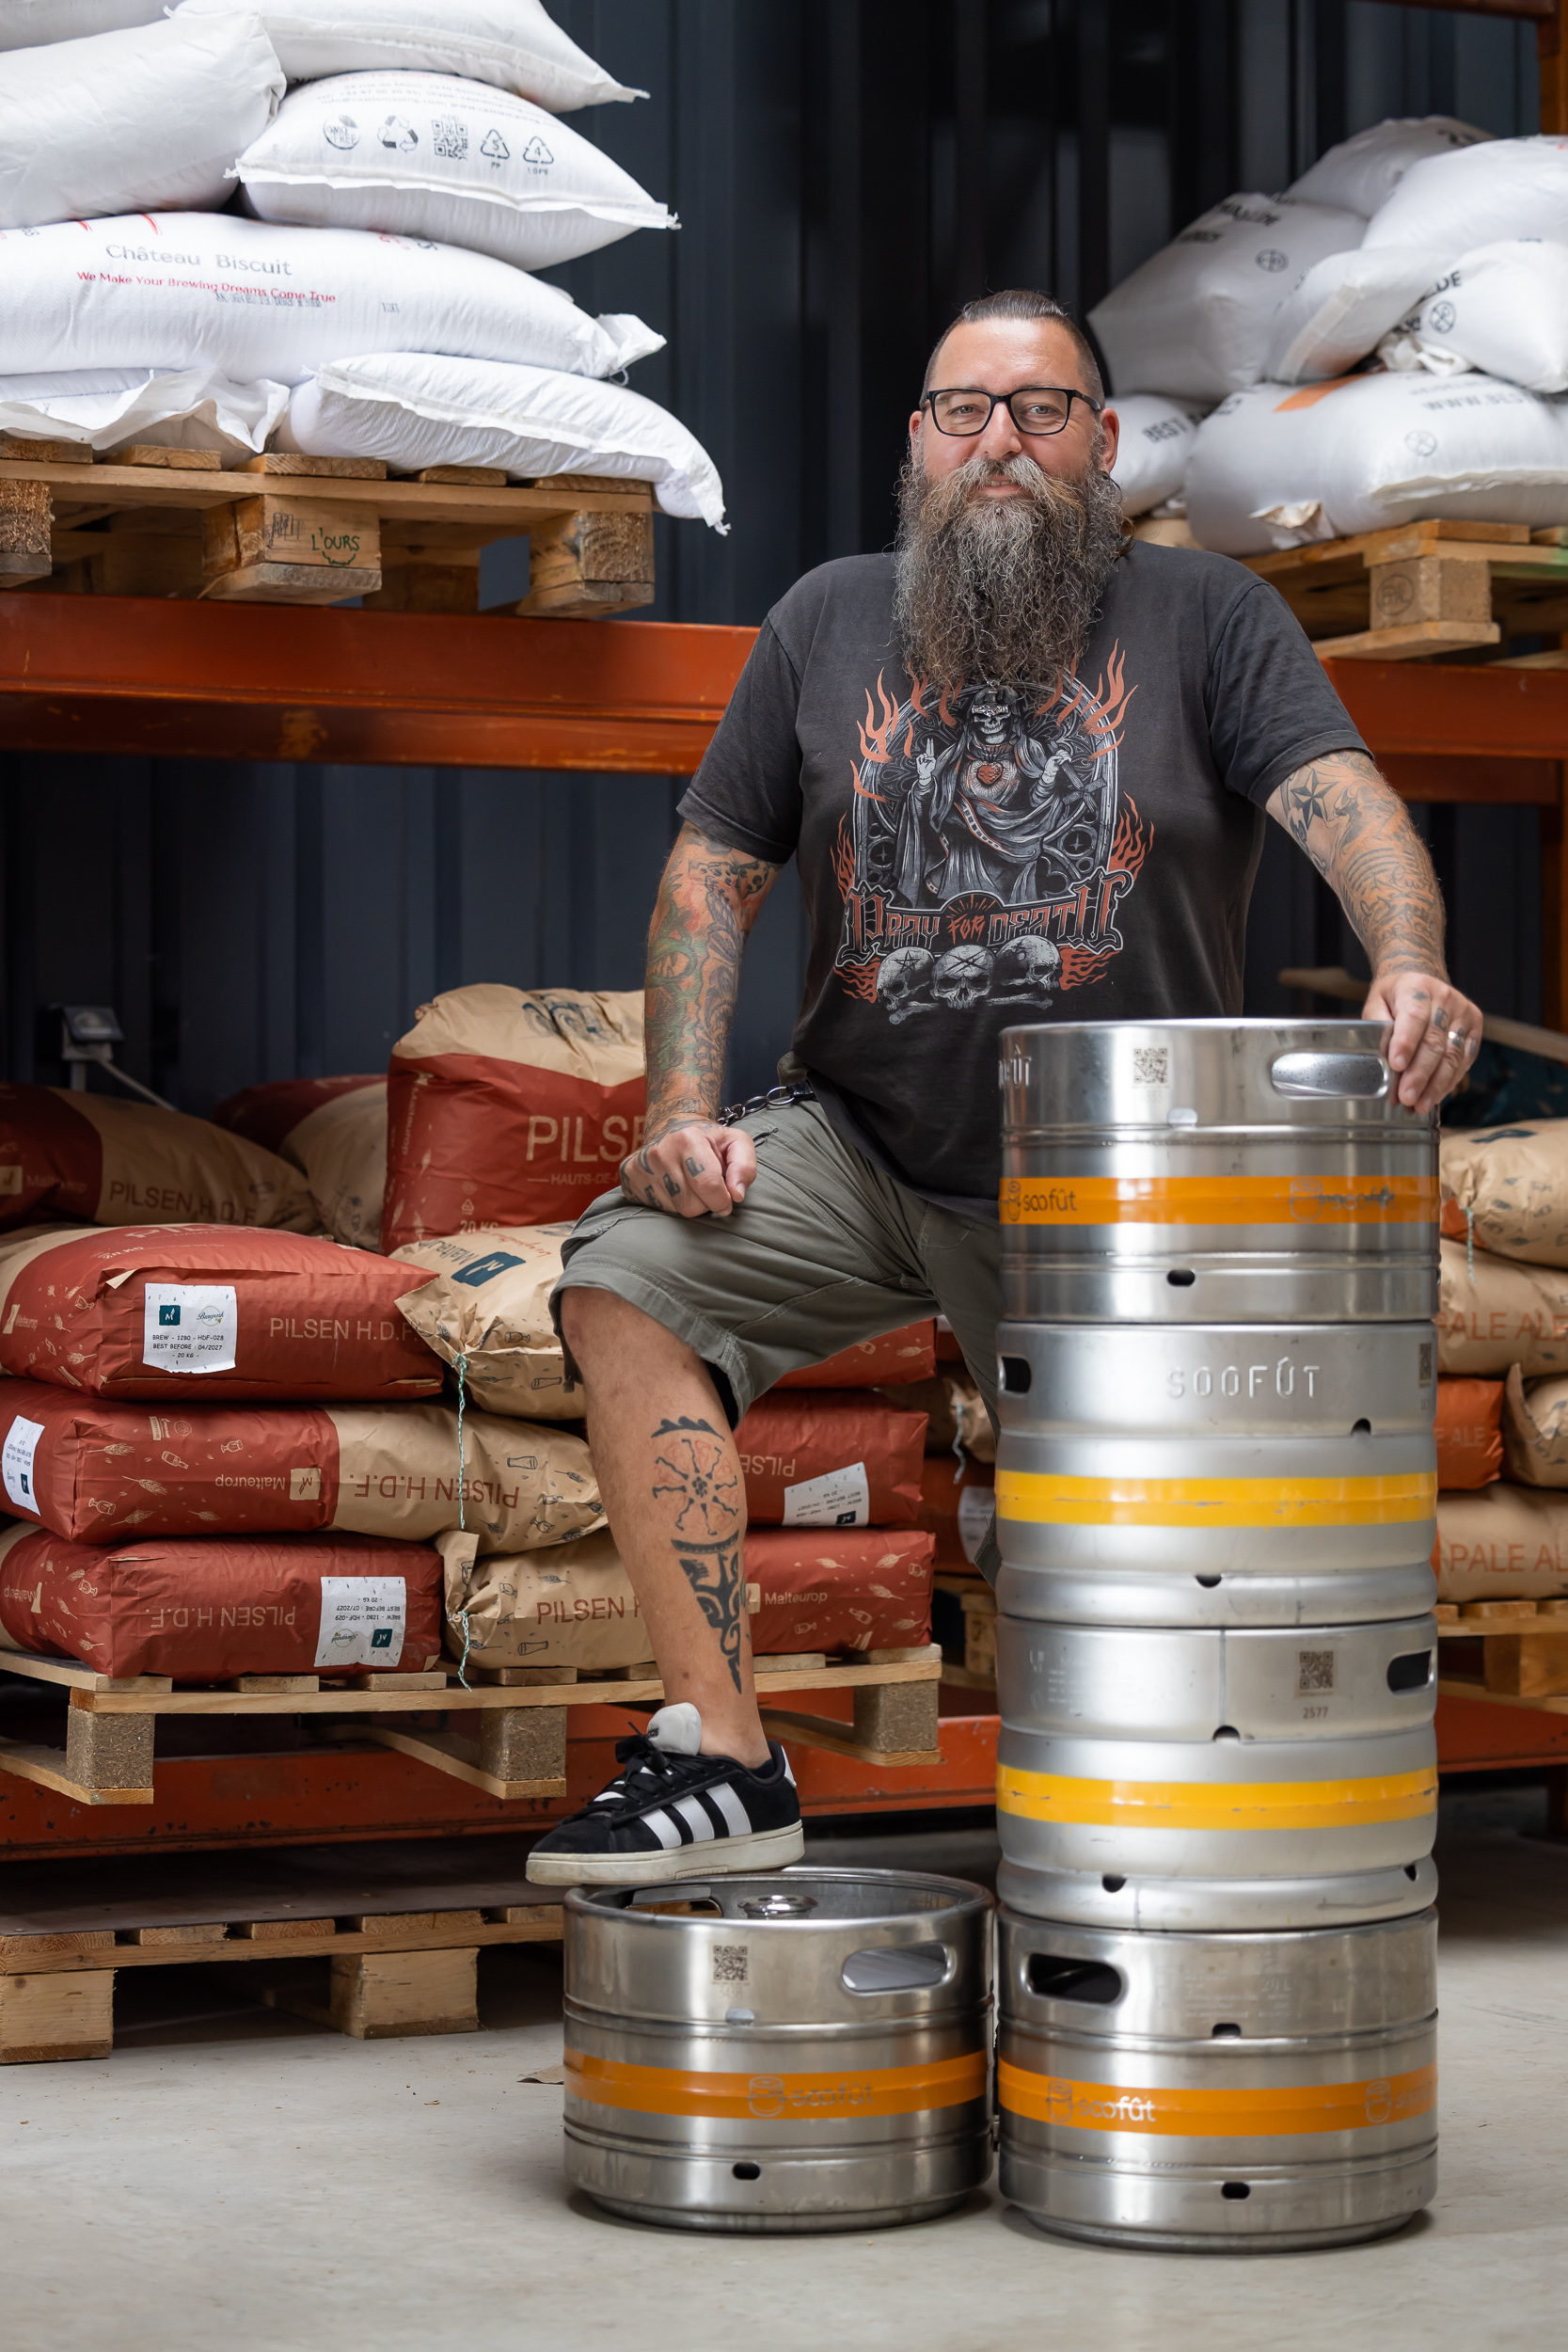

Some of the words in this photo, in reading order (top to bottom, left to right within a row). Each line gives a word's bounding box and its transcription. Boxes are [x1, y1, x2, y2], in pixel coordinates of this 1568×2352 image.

[105, 244, 200, 266] Château
[215, 253, 293, 277] Biscuit
[77, 271, 96, 282] We
[100, 272, 133, 285] Make
[135, 276, 165, 287] Your
[168, 278, 218, 294] Brewing
[221, 282, 267, 297] Dreams
[270, 287, 306, 300] Come
[309, 291, 336, 303] True
[311, 527, 360, 552] L'OURS
[947, 913, 986, 946] FOR
[987, 871, 1132, 949] DEATH
[402, 1085, 420, 1156] Malteurop
[526, 1114, 646, 1164] PILS
[551, 1173, 620, 1186] HAUTS-DE-
[109, 1180, 194, 1213] PILSEN
[1022, 1187, 1078, 1212] soofût
[270, 1317, 349, 1340] PILSEN
[1165, 1356, 1321, 1399] SOOFÛT
[739, 1454, 796, 1478] PILSE
[214, 1474, 285, 1490] Malteurop
[435, 1478, 520, 1509] PILSEN
[1449, 1543, 1526, 1573] PALE
[1533, 1543, 1568, 1573] AL
[536, 1596, 625, 1625] PILSEN
[765, 1592, 828, 1606] Malteurop
[221, 1605, 296, 1628] PILSEN
[1303, 1706, 1329, 1720] 2577
[792, 2081, 875, 2107] soofût
[1078, 2095, 1157, 2122] soofût
